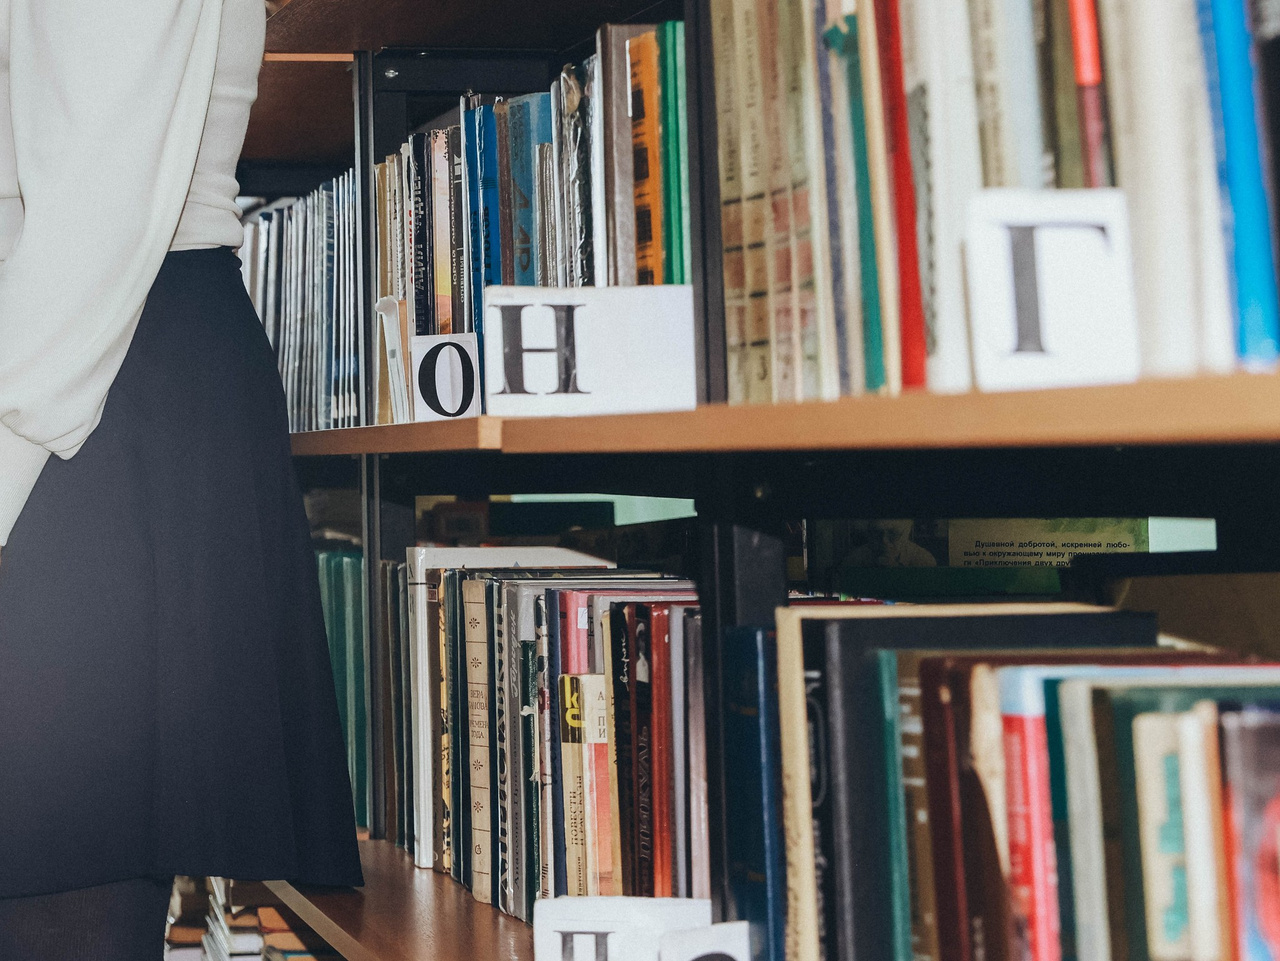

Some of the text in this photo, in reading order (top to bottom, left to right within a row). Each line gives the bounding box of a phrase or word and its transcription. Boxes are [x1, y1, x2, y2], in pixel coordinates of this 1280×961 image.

[1002, 224, 1111, 355] Г
[418, 342, 475, 418] О
[487, 304, 592, 395] Н
[974, 540, 1015, 549] Душевной
[1018, 540, 1058, 549] добротой,
[1061, 541, 1102, 549] искренней
[988, 550, 1044, 559] окружающему
[1046, 550, 1066, 559] миру
[566, 790, 580, 845] ПОВЕСТИ
